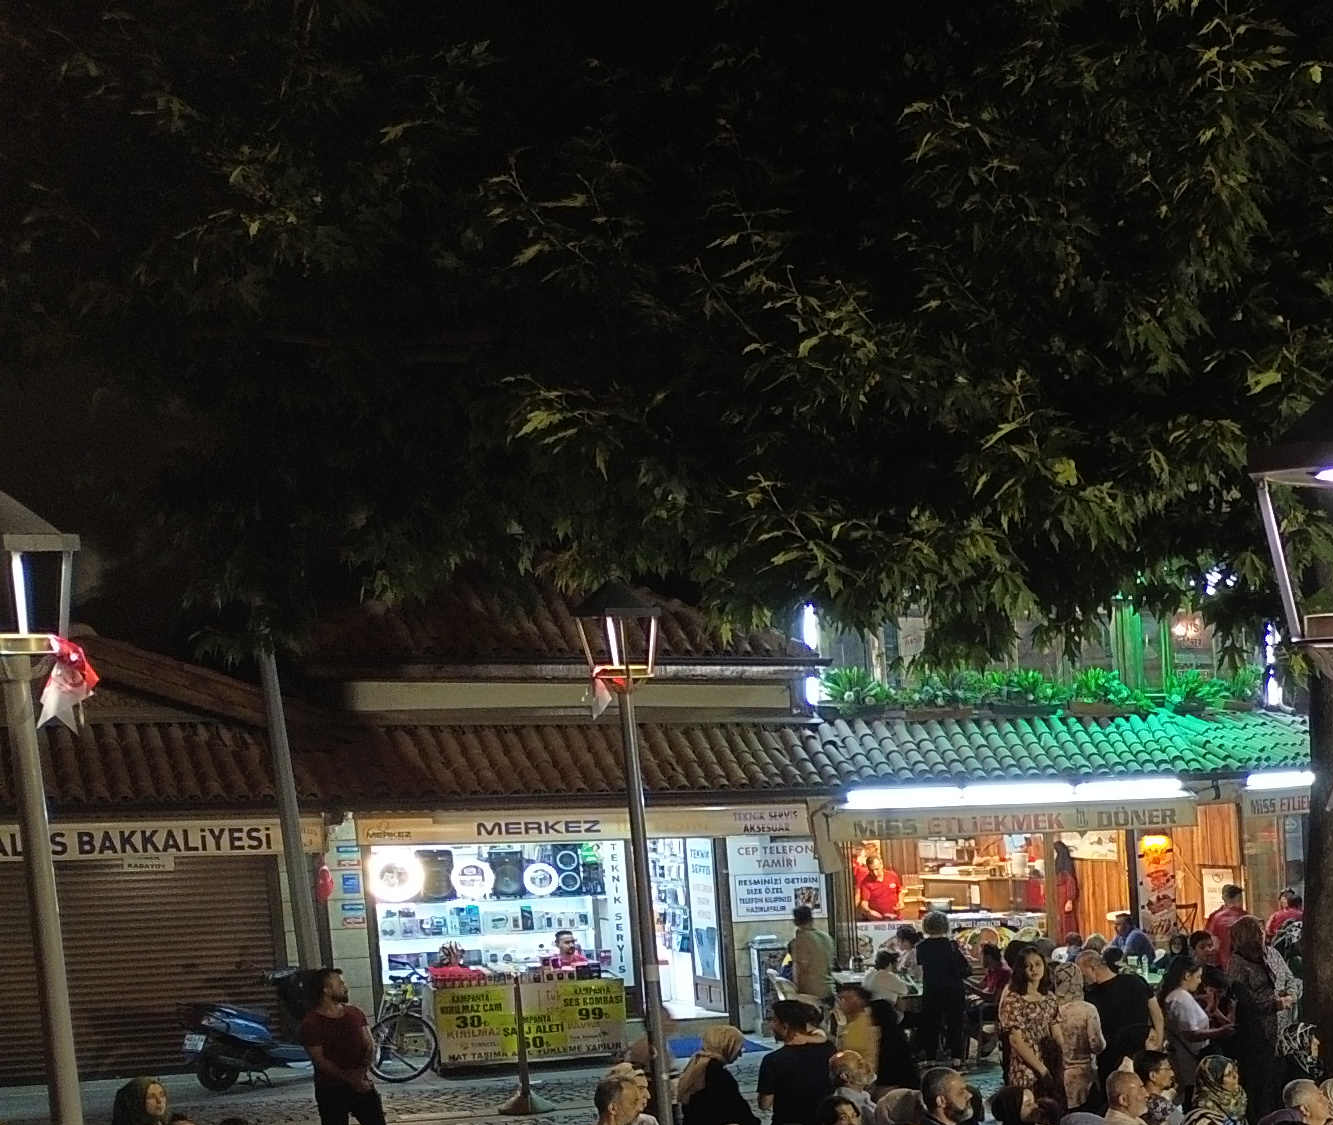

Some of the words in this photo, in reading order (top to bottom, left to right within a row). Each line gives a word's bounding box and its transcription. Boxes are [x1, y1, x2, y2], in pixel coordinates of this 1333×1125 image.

[1097, 806, 1177, 828] DÖNER
[476, 819, 602, 836] MERKEZ
[737, 846, 758, 856] CEP
[756, 856, 797, 868] TAMİRİ
[610, 843, 622, 904] TEKNİK
[563, 998, 580, 1007] SES
[582, 995, 623, 1006] BOMBASI
[440, 1004, 481, 1015] KIRILMAZ
